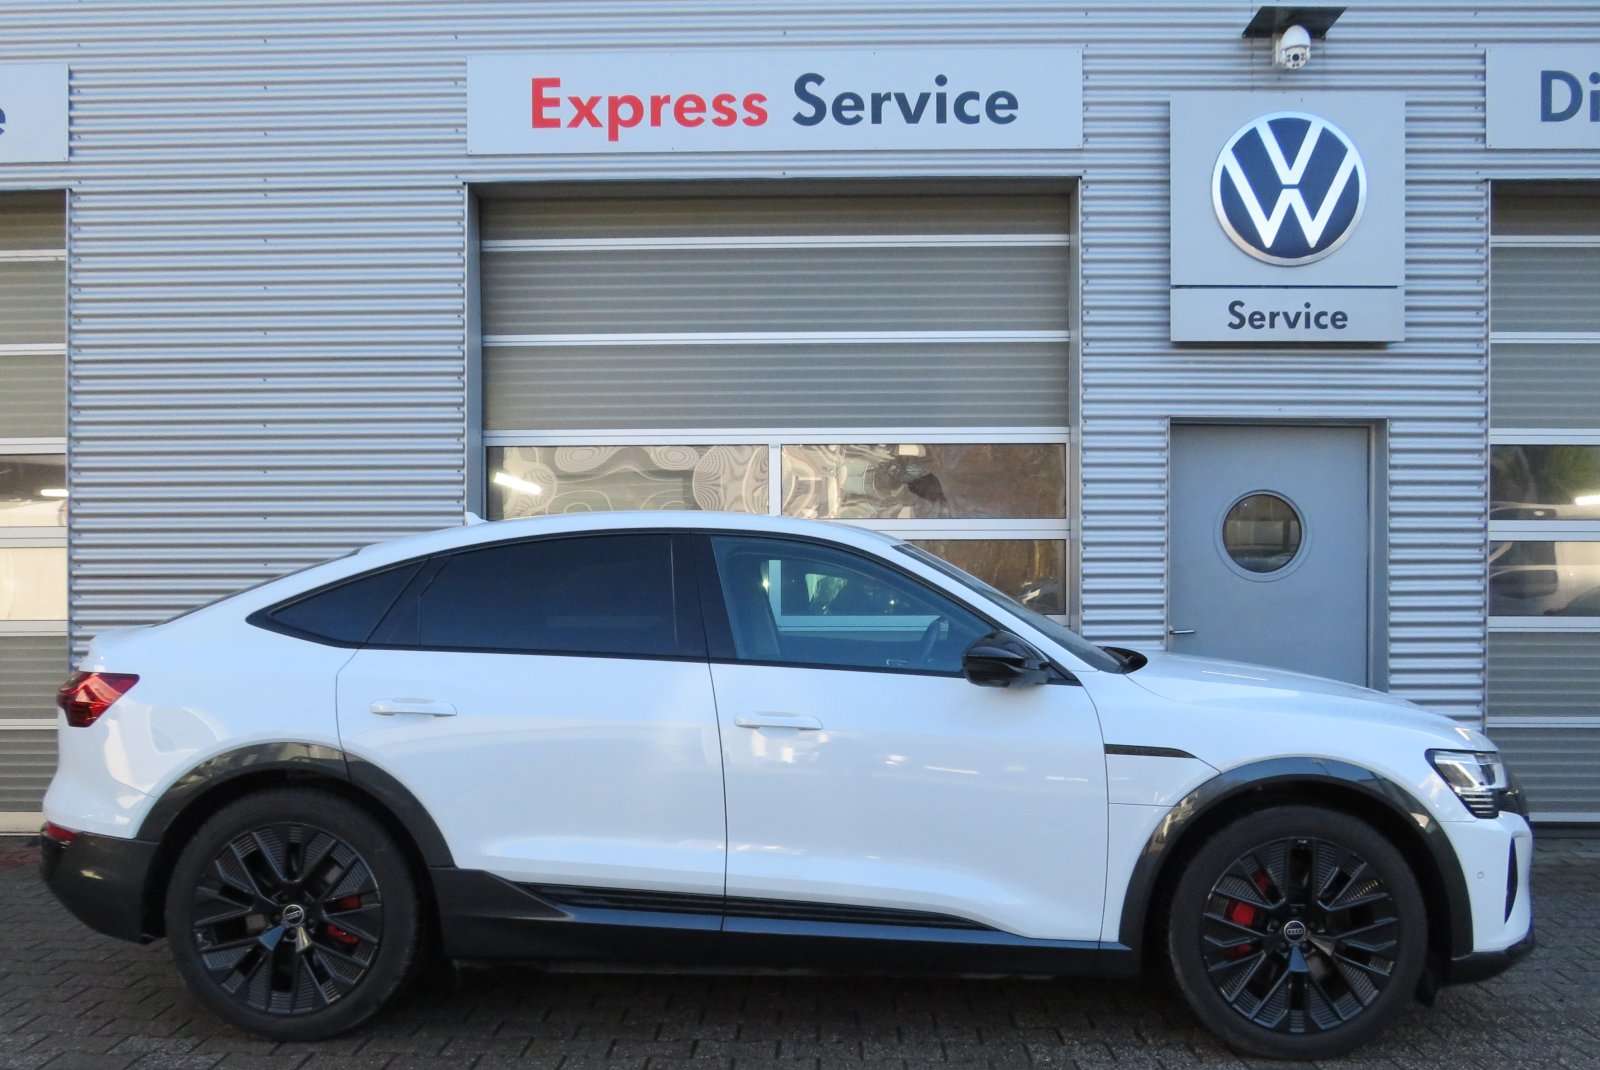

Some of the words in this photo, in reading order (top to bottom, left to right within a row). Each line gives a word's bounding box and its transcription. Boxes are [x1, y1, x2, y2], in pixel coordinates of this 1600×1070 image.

[531, 77, 769, 142] Express
[792, 73, 1019, 127] Service
[1227, 300, 1349, 330] Service
